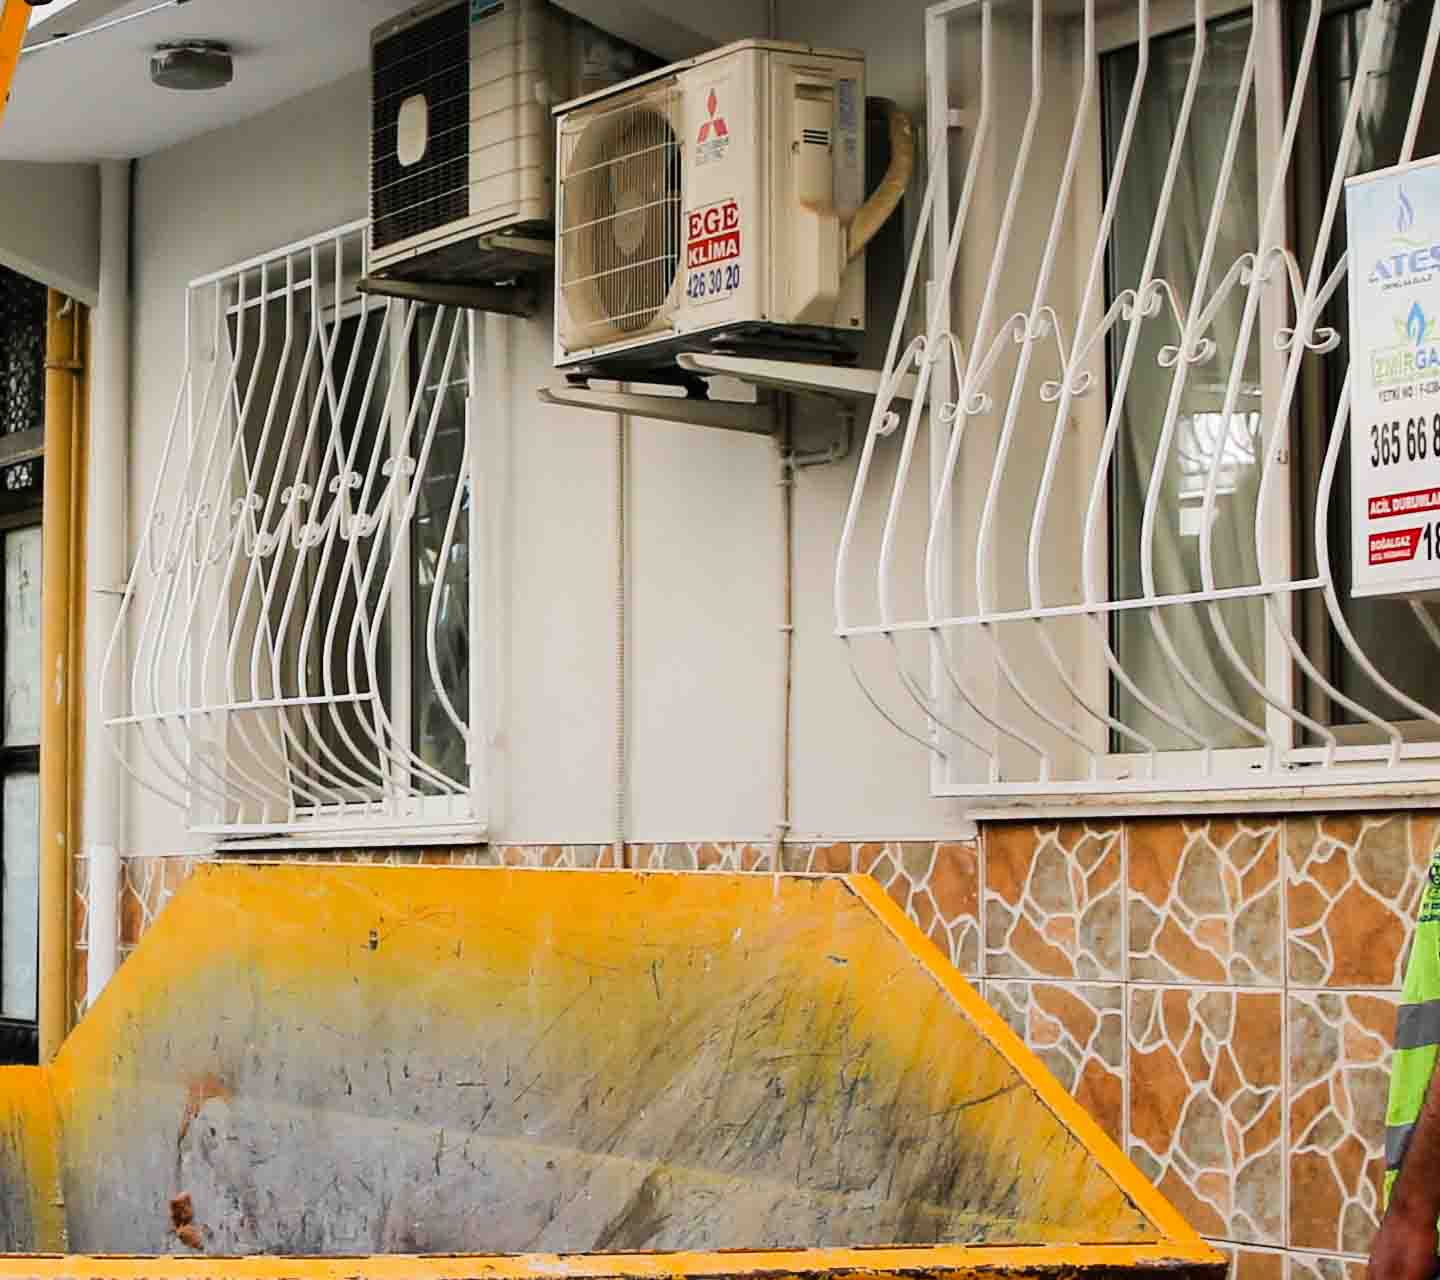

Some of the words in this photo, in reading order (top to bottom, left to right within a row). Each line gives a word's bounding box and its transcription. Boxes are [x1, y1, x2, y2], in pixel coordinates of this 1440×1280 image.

[688, 203, 739, 240] EGE
[688, 237, 738, 267] KLİMA
[708, 269, 721, 295] 30
[726, 263, 740, 291] 20
[1370, 422, 1401, 468] 365
[1406, 416, 1426, 461] 66
